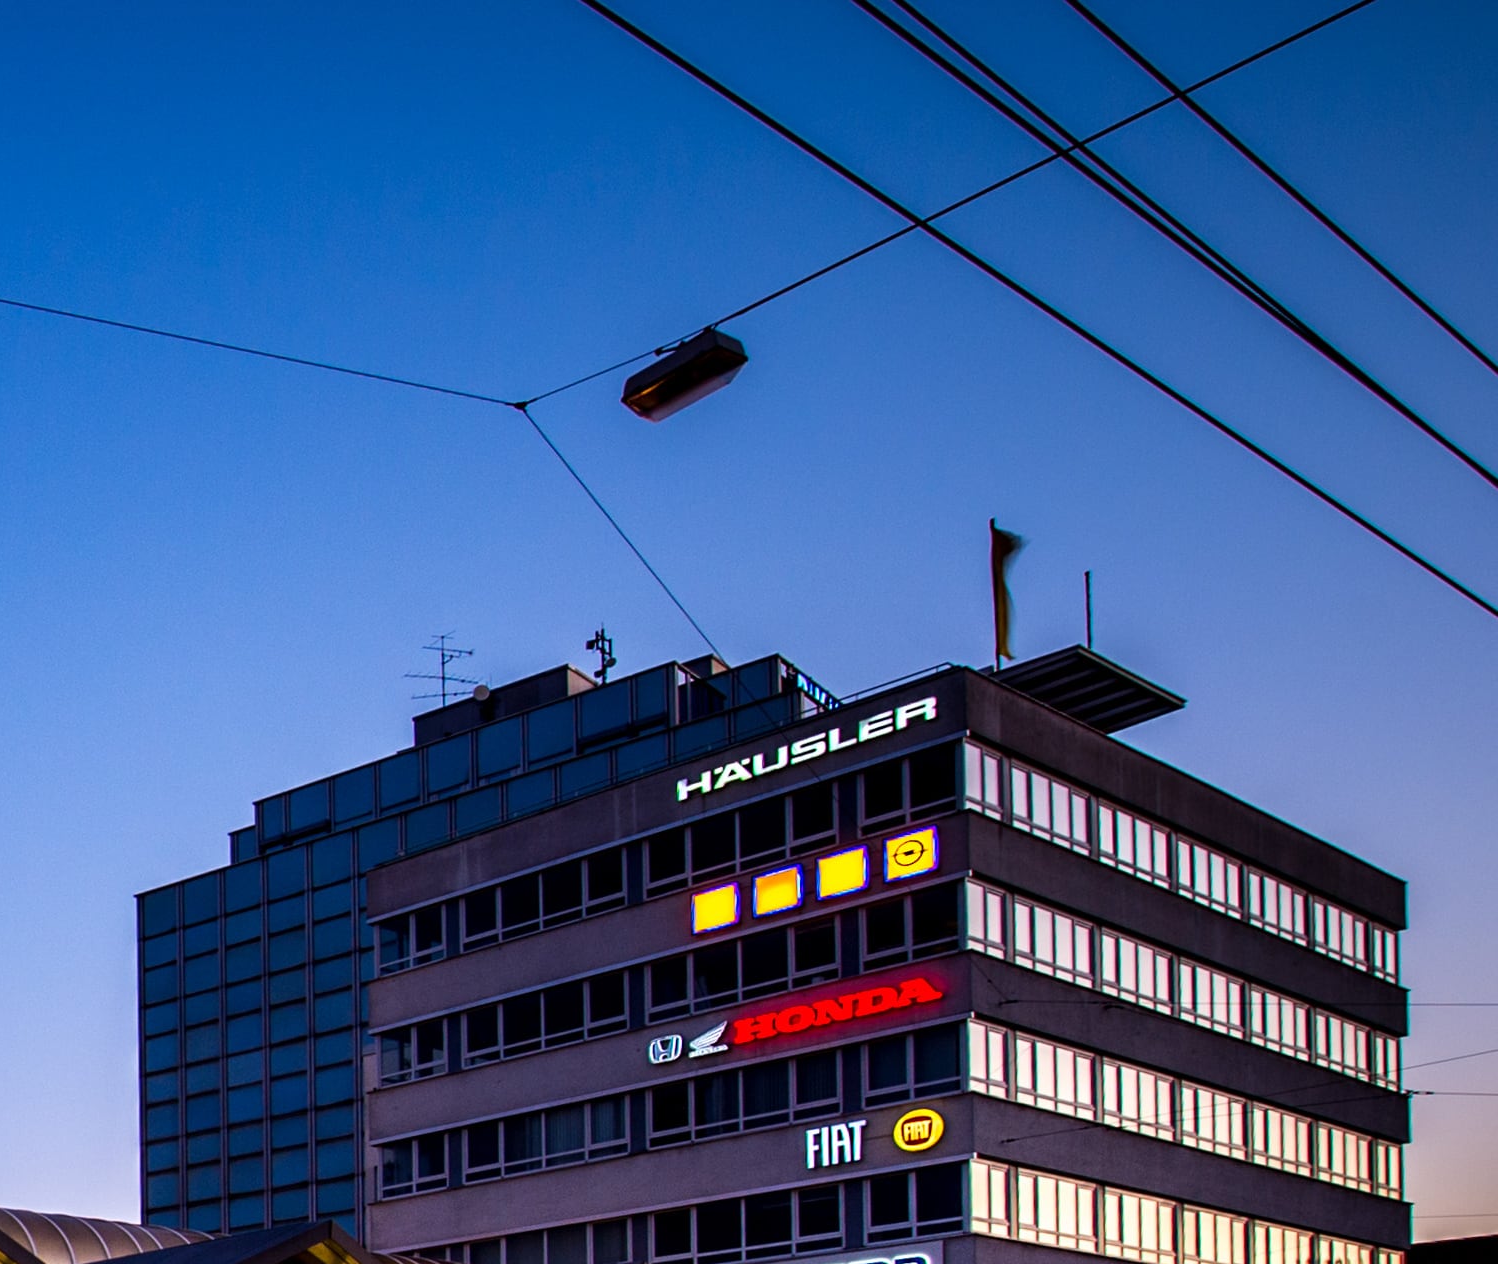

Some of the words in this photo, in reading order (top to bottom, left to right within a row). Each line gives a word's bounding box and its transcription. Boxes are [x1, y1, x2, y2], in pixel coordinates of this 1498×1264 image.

[676, 696, 939, 802] HÄUSLER
[733, 977, 943, 1044] HONDA
[805, 1119, 867, 1170] FIAT
[904, 1120, 931, 1142] FIAT
